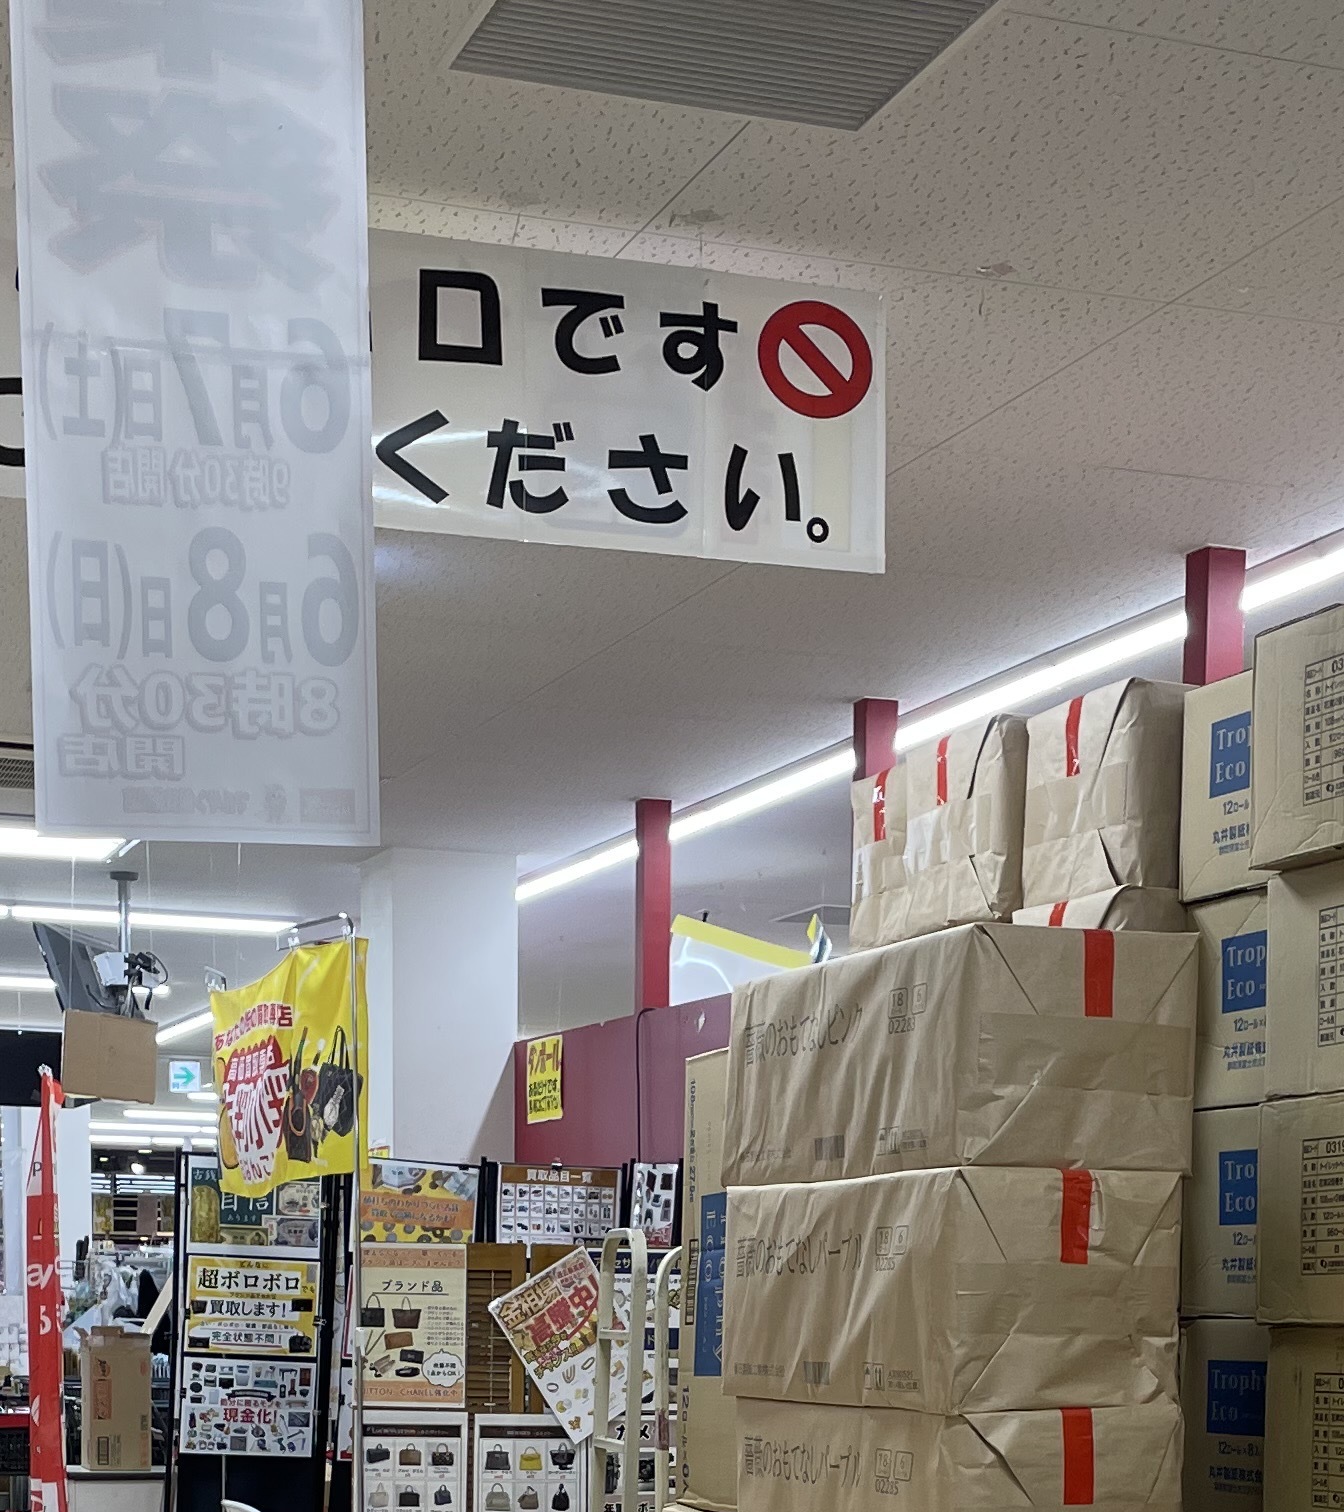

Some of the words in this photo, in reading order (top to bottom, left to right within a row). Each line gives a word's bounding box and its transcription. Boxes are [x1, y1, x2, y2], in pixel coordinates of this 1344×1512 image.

[418, 268, 739, 391] 口です
[375, 408, 830, 544] ください。
[1214, 759, 1247, 783] Eco
[1213, 823, 1250, 844] 丸井製紙
[1226, 976, 1257, 999] Eco
[1223, 1189, 1256, 1211] Eco
[198, 1267, 301, 1291] 超ボロボロ
[381, 1279, 444, 1293] ブランド品
[209, 1299, 287, 1319] 買取します!
[499, 1276, 563, 1330] 金相場
[1210, 1368, 1267, 1391] Troph
[223, 1407, 278, 1425] 現金化!
[1210, 1400, 1239, 1422] Eco
